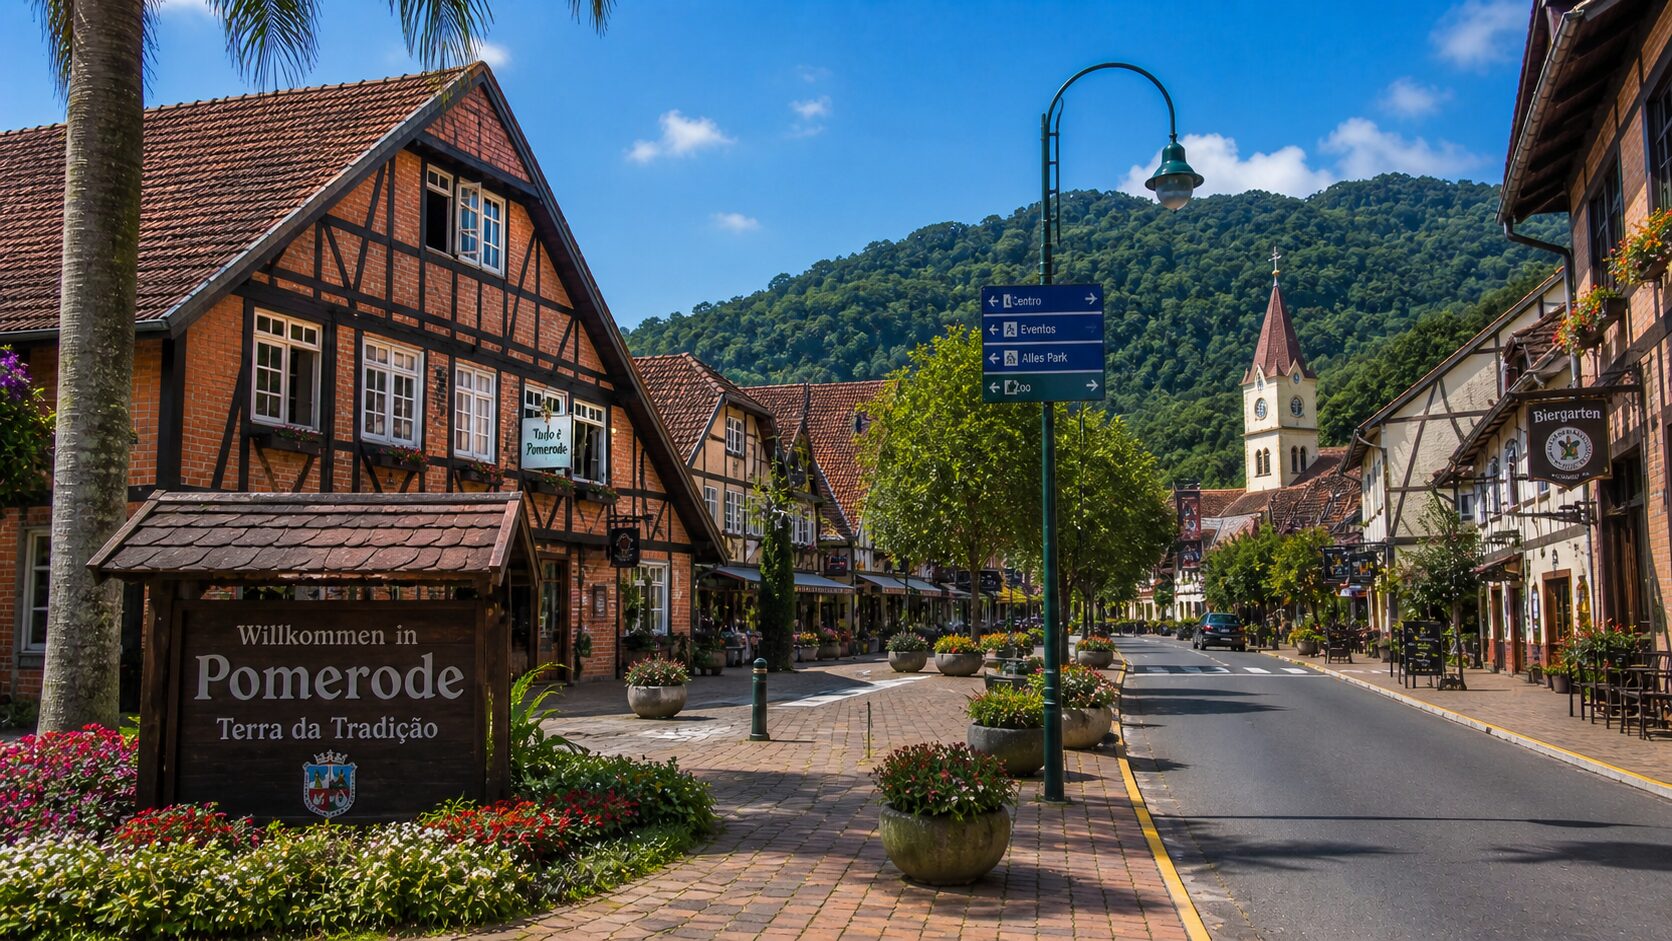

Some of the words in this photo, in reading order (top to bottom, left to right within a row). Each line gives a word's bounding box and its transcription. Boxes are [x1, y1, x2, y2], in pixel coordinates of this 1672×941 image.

[1021, 324, 1056, 334] Eventos
[1022, 353, 1044, 363] Alles
[1048, 352, 1068, 362] Park
[1533, 407, 1600, 423] Biergarten
[526, 442, 568, 456] Pomerode
[237, 624, 385, 646] Willkommen
[395, 624, 418, 645] in
[194, 652, 464, 700] Pomerode
[216, 718, 283, 740] Terra
[292, 717, 322, 740] da
[330, 716, 438, 744] Tradição
